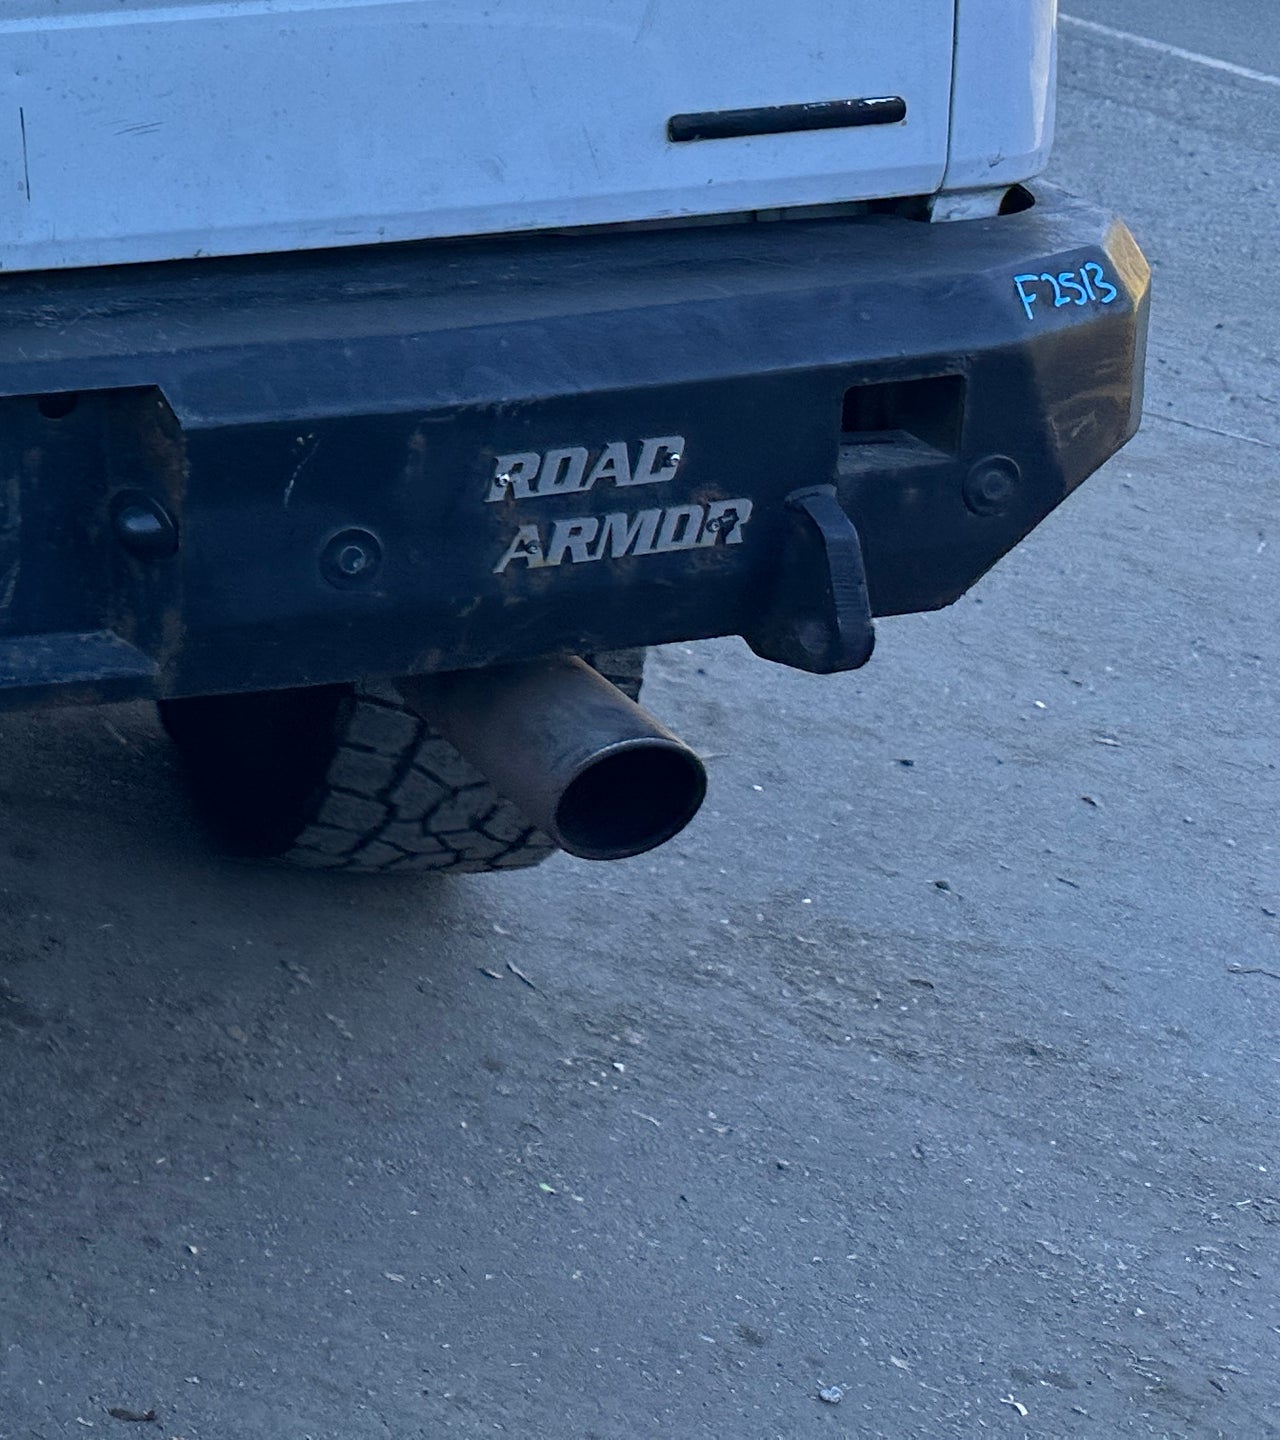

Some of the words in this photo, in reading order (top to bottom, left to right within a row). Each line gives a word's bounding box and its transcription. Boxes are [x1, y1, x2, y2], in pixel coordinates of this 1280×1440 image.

[1013, 262, 1118, 320] F2513
[483, 435, 686, 503] ROAD
[492, 498, 753, 574] ARMOR
